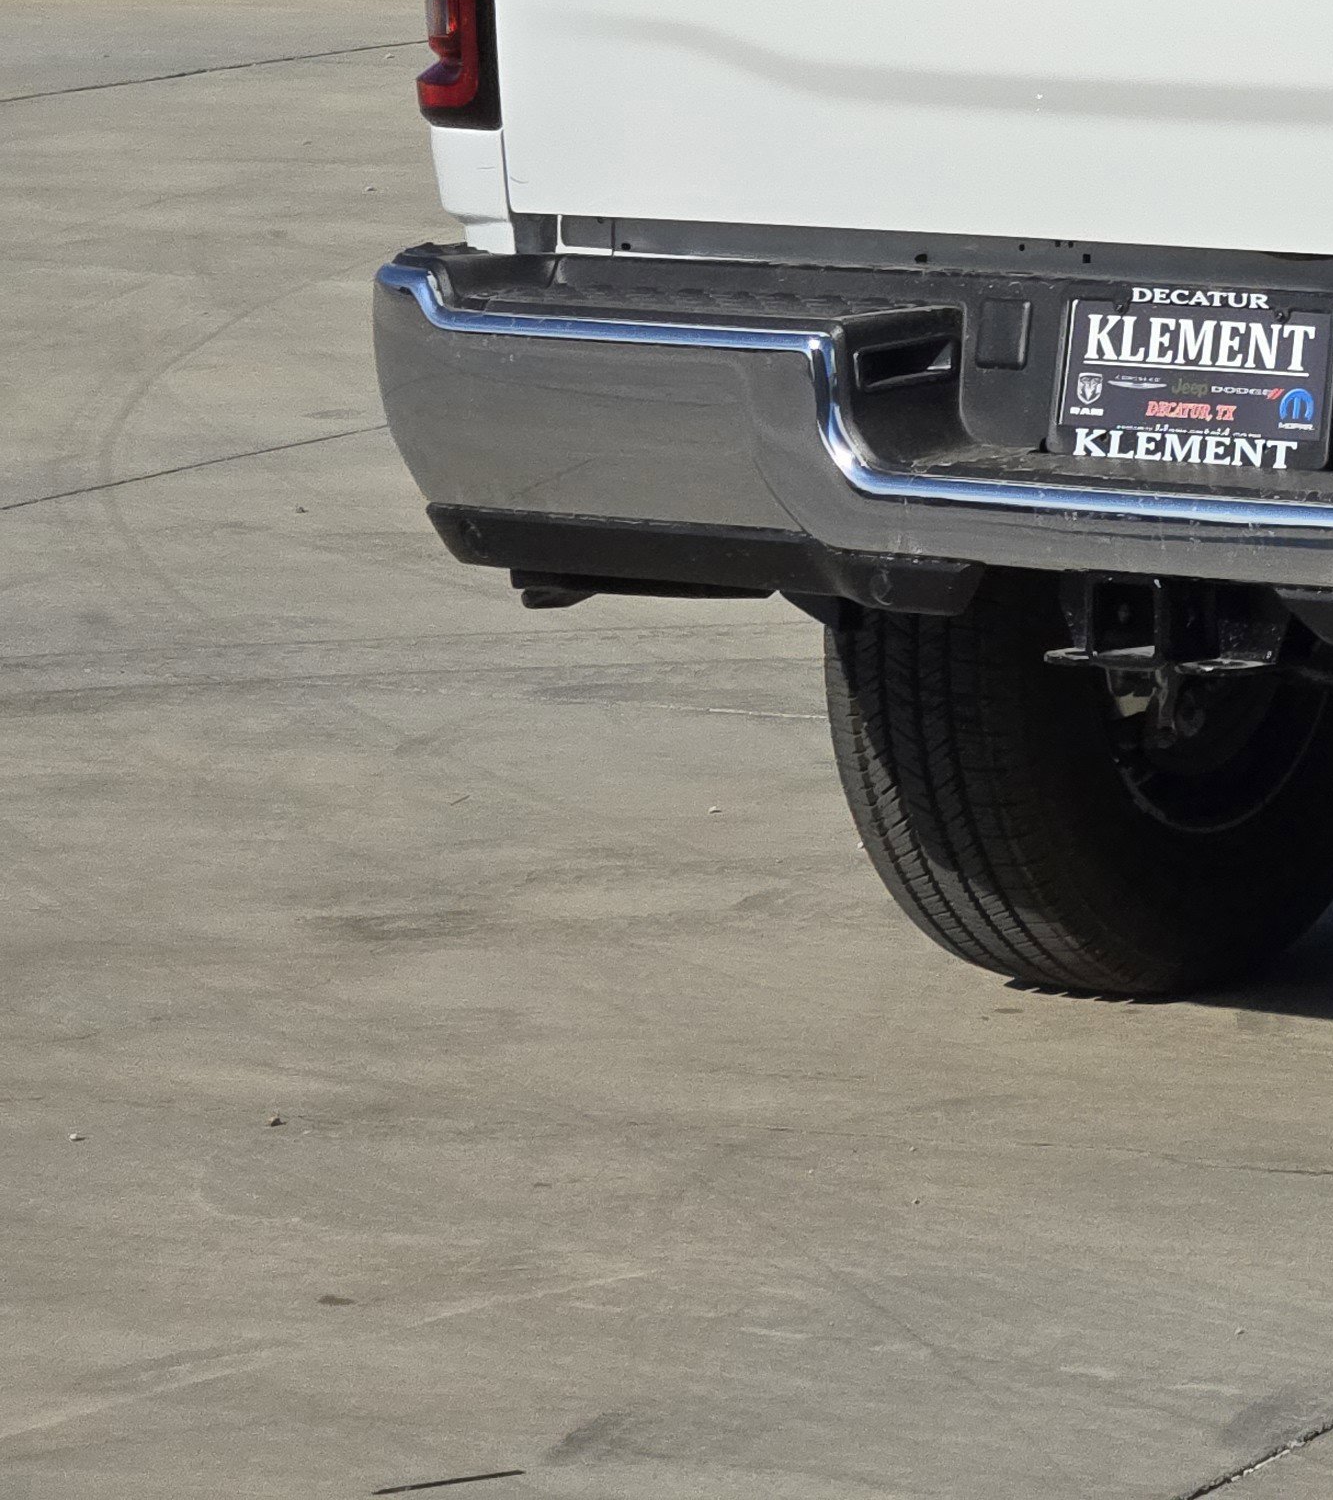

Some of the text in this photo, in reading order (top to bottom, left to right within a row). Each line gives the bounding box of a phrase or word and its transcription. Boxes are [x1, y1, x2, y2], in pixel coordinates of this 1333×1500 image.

[1131, 286, 1269, 310] DECATUR
[1084, 313, 1316, 372] KLEMENT
[1171, 378, 1208, 398] Jeep
[1216, 404, 1237, 421] TX
[1072, 427, 1298, 470] KLEMENT
